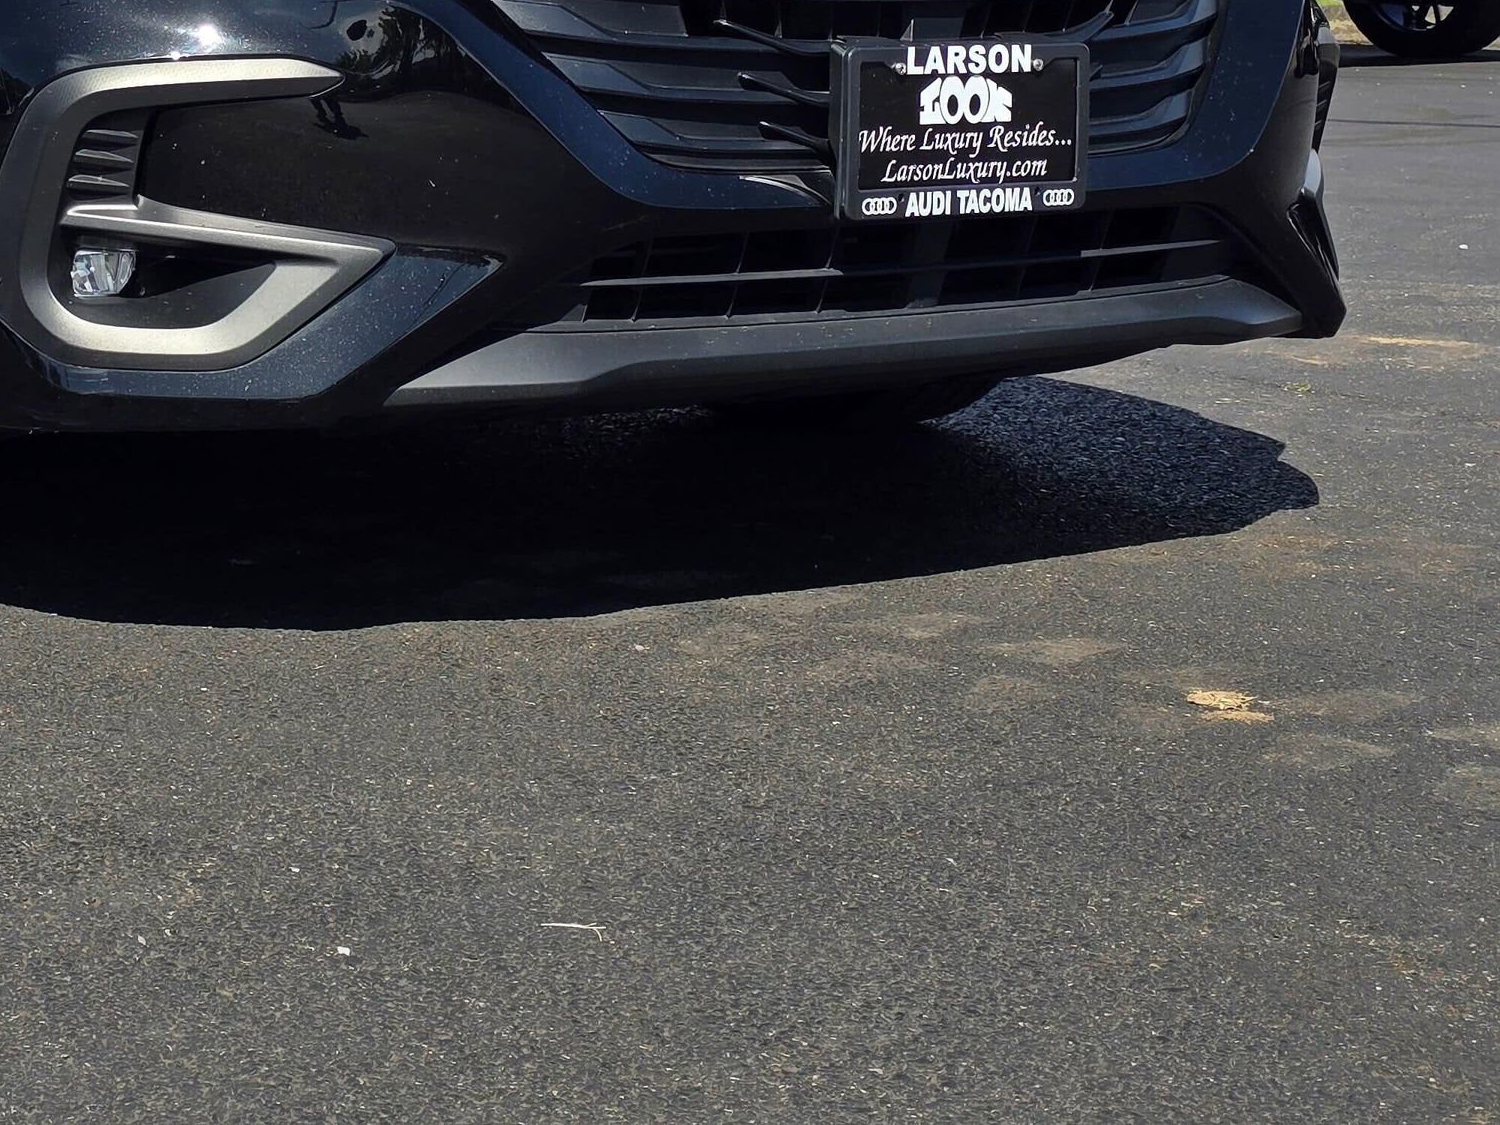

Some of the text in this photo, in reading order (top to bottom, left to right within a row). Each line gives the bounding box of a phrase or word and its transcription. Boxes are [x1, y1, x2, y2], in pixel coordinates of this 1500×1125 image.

[906, 44, 1032, 75] LARSON
[859, 121, 1072, 158] Where Luxury Resides...
[881, 157, 1048, 184] LarsonLuxury.com
[905, 187, 1033, 217] AUDI TACOMA
